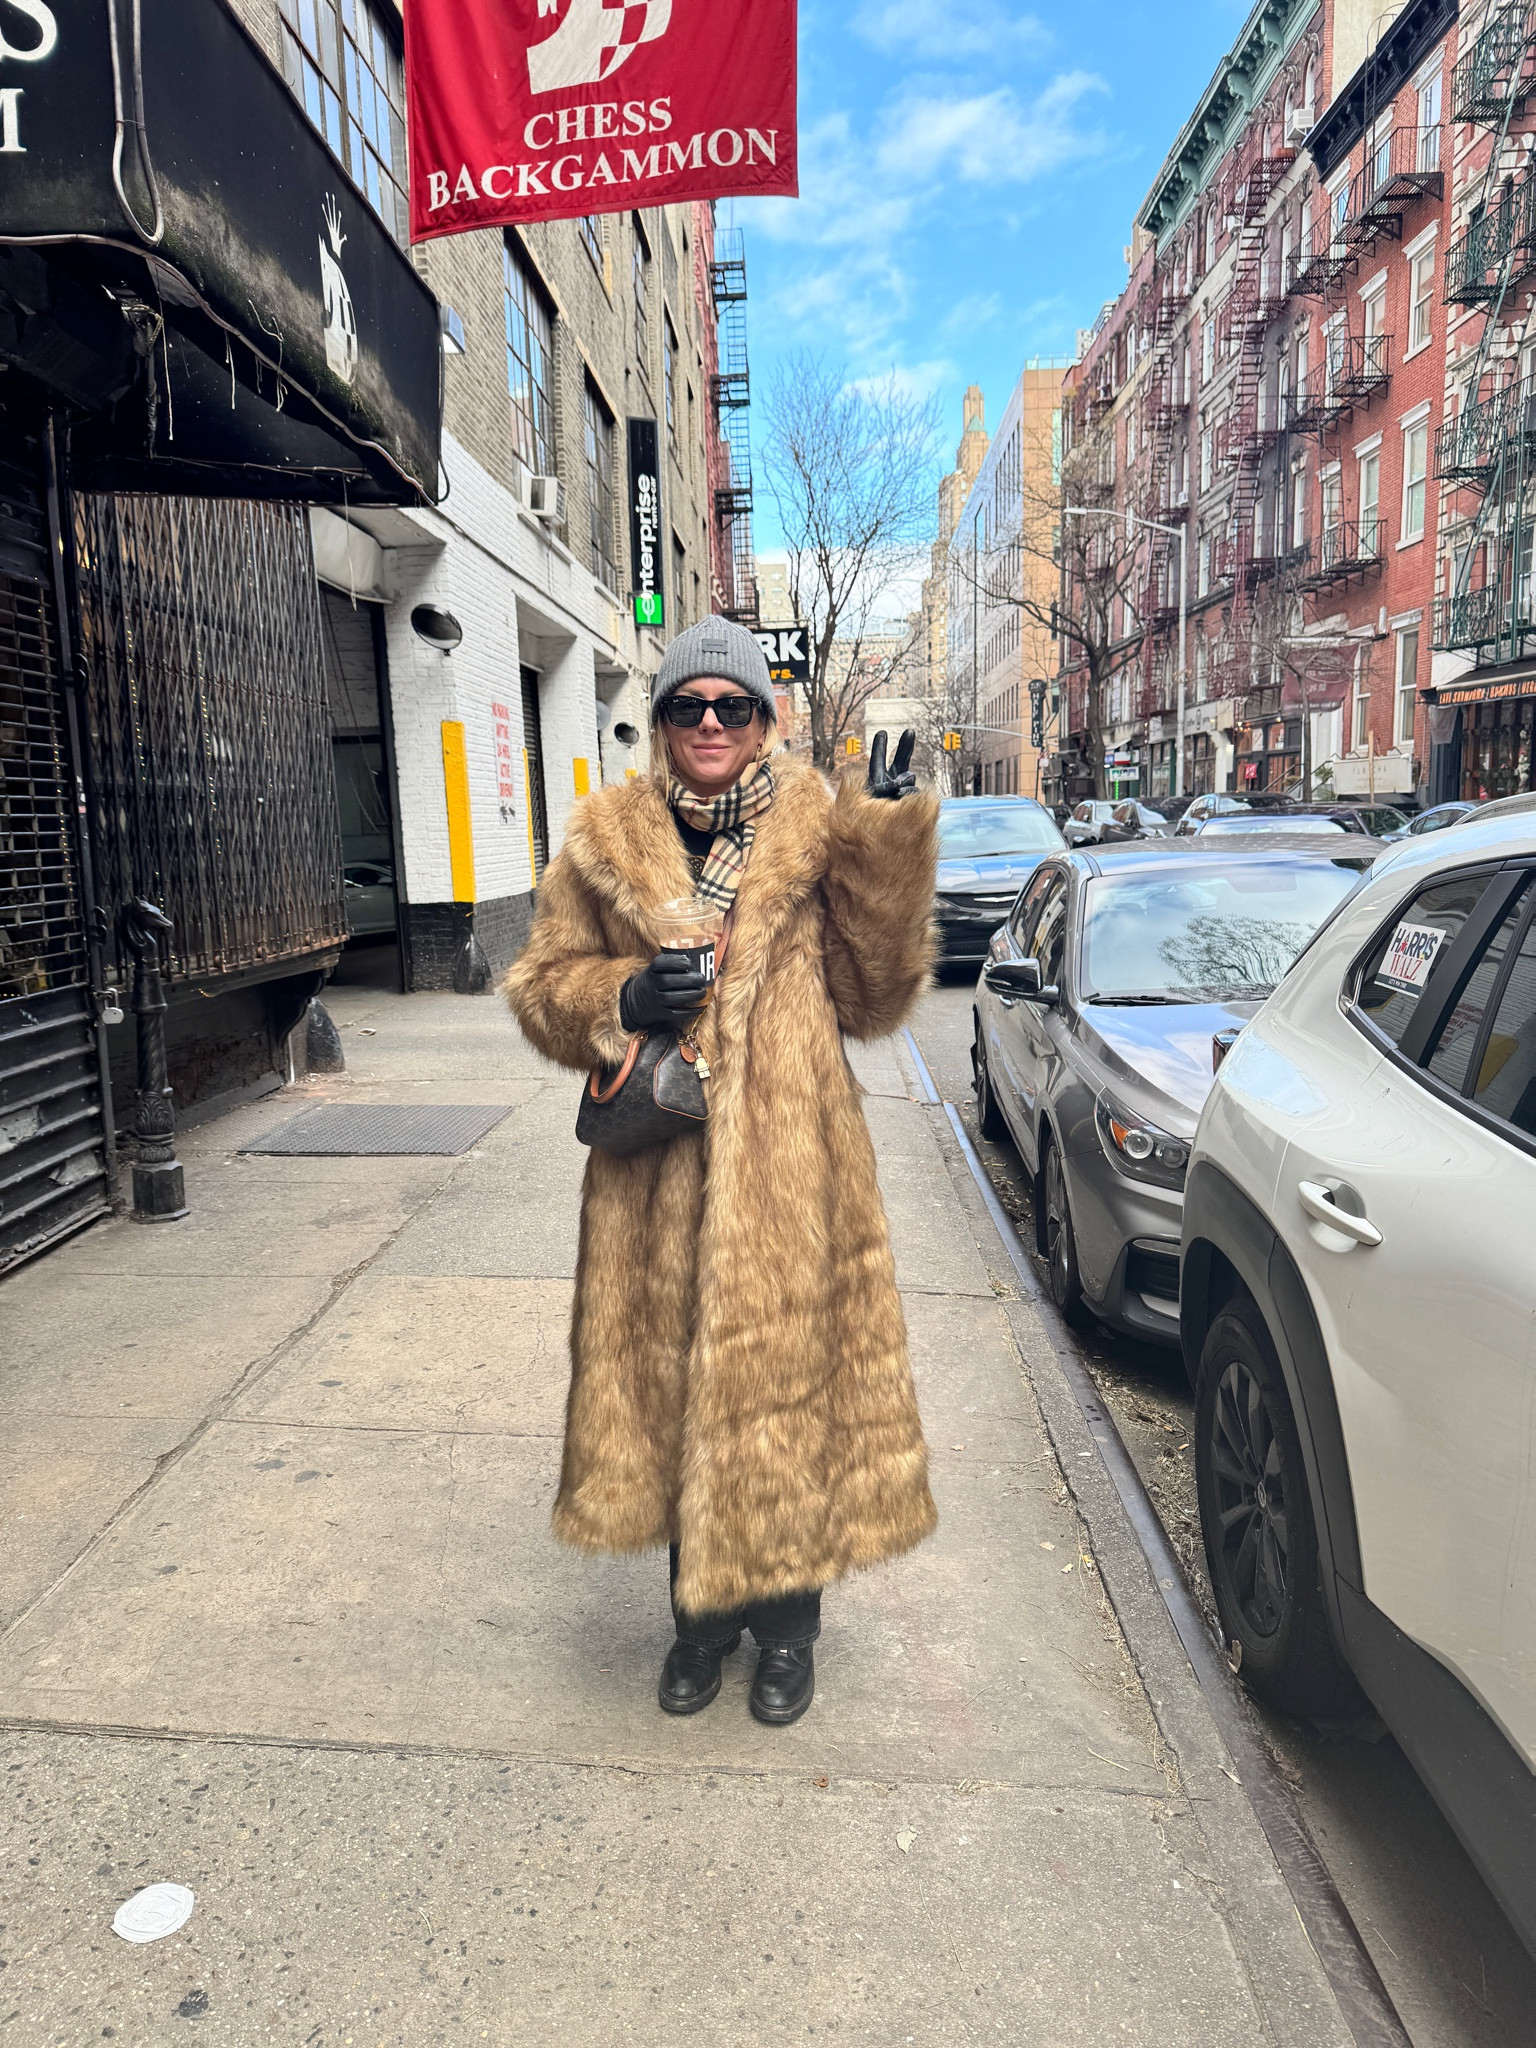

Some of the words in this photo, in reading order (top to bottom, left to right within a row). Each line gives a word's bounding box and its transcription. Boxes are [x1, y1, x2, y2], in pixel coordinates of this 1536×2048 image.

[523, 95, 672, 151] CHESS
[427, 127, 779, 212] BACKGAMMON
[635, 473, 657, 624] enterprise
[1389, 953, 1423, 981] WALZ
[1390, 928, 1439, 961] HARRIS
